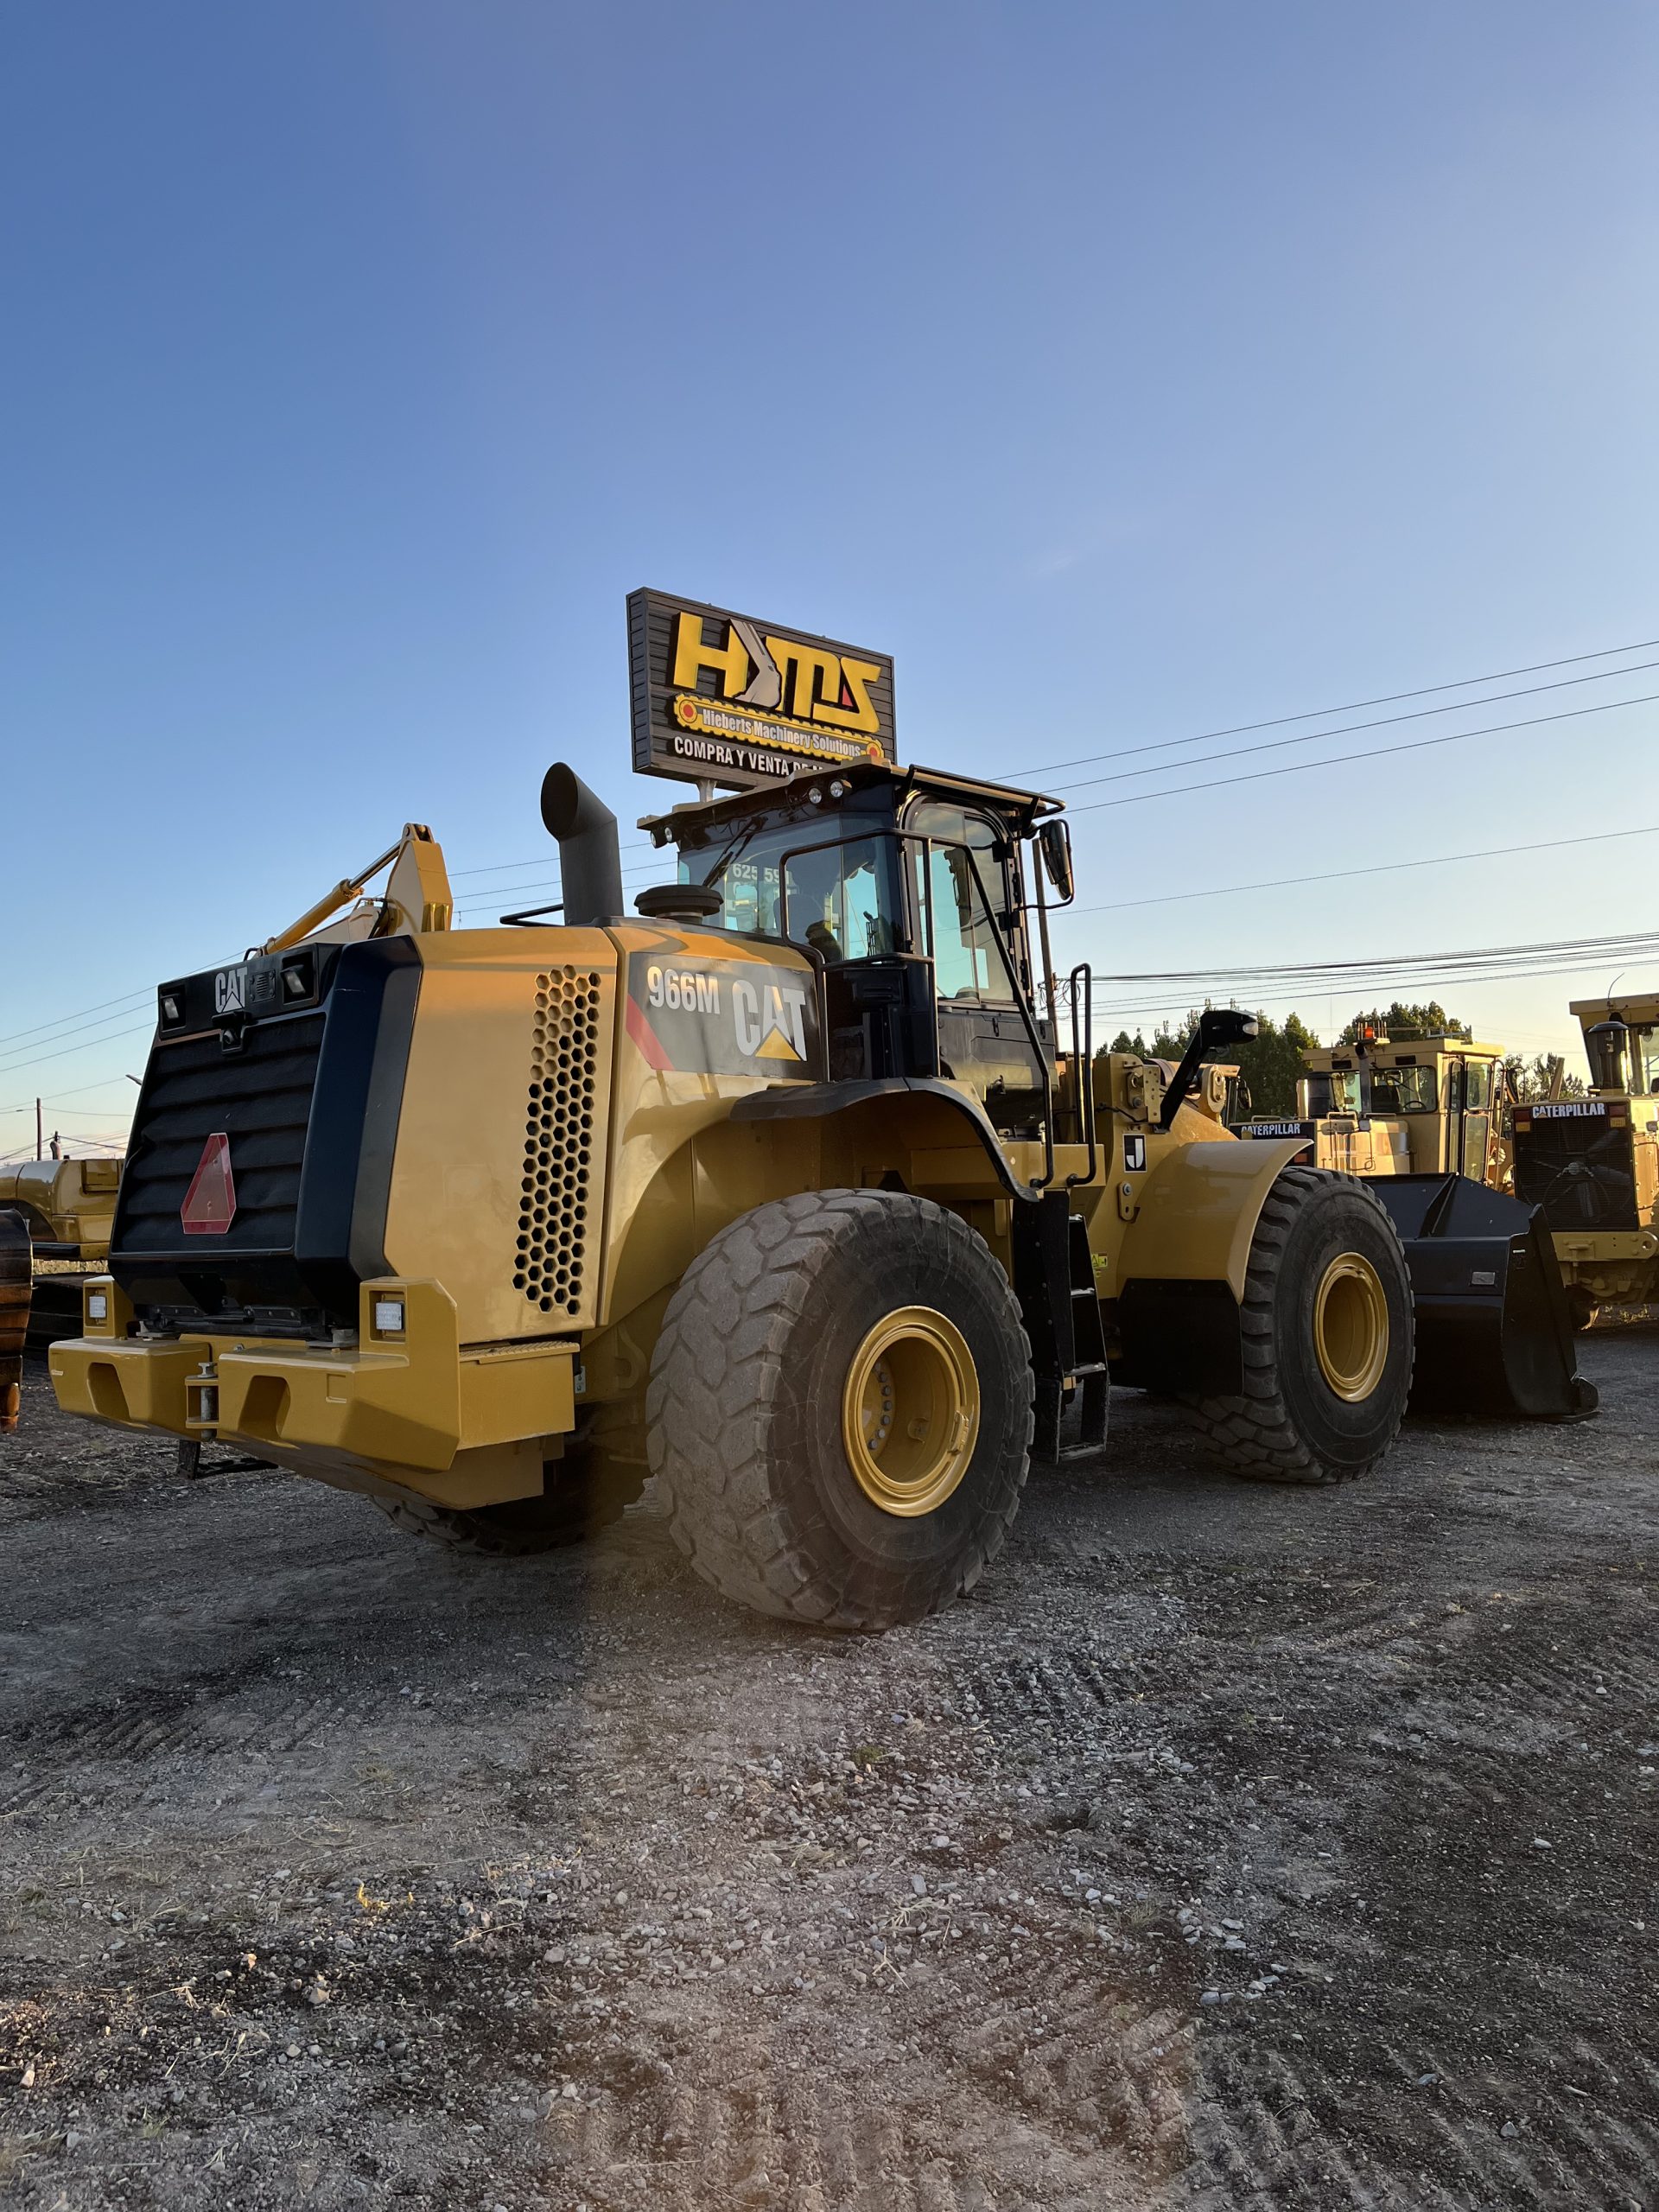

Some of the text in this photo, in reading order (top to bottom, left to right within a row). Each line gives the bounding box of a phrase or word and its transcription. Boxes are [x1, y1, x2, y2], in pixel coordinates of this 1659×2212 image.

[674, 736, 734, 765] COMPRA
[736, 749, 744, 766] Y
[748, 752, 790, 776] VENTA
[702, 709, 861, 757] Hieberts Machinery Solutions
[733, 864, 758, 880] 625
[215, 967, 247, 1014] CAT
[647, 966, 721, 1014] 966M
[733, 979, 807, 1061] CAT
[1532, 1103, 1605, 1118] CATERPILLAR
